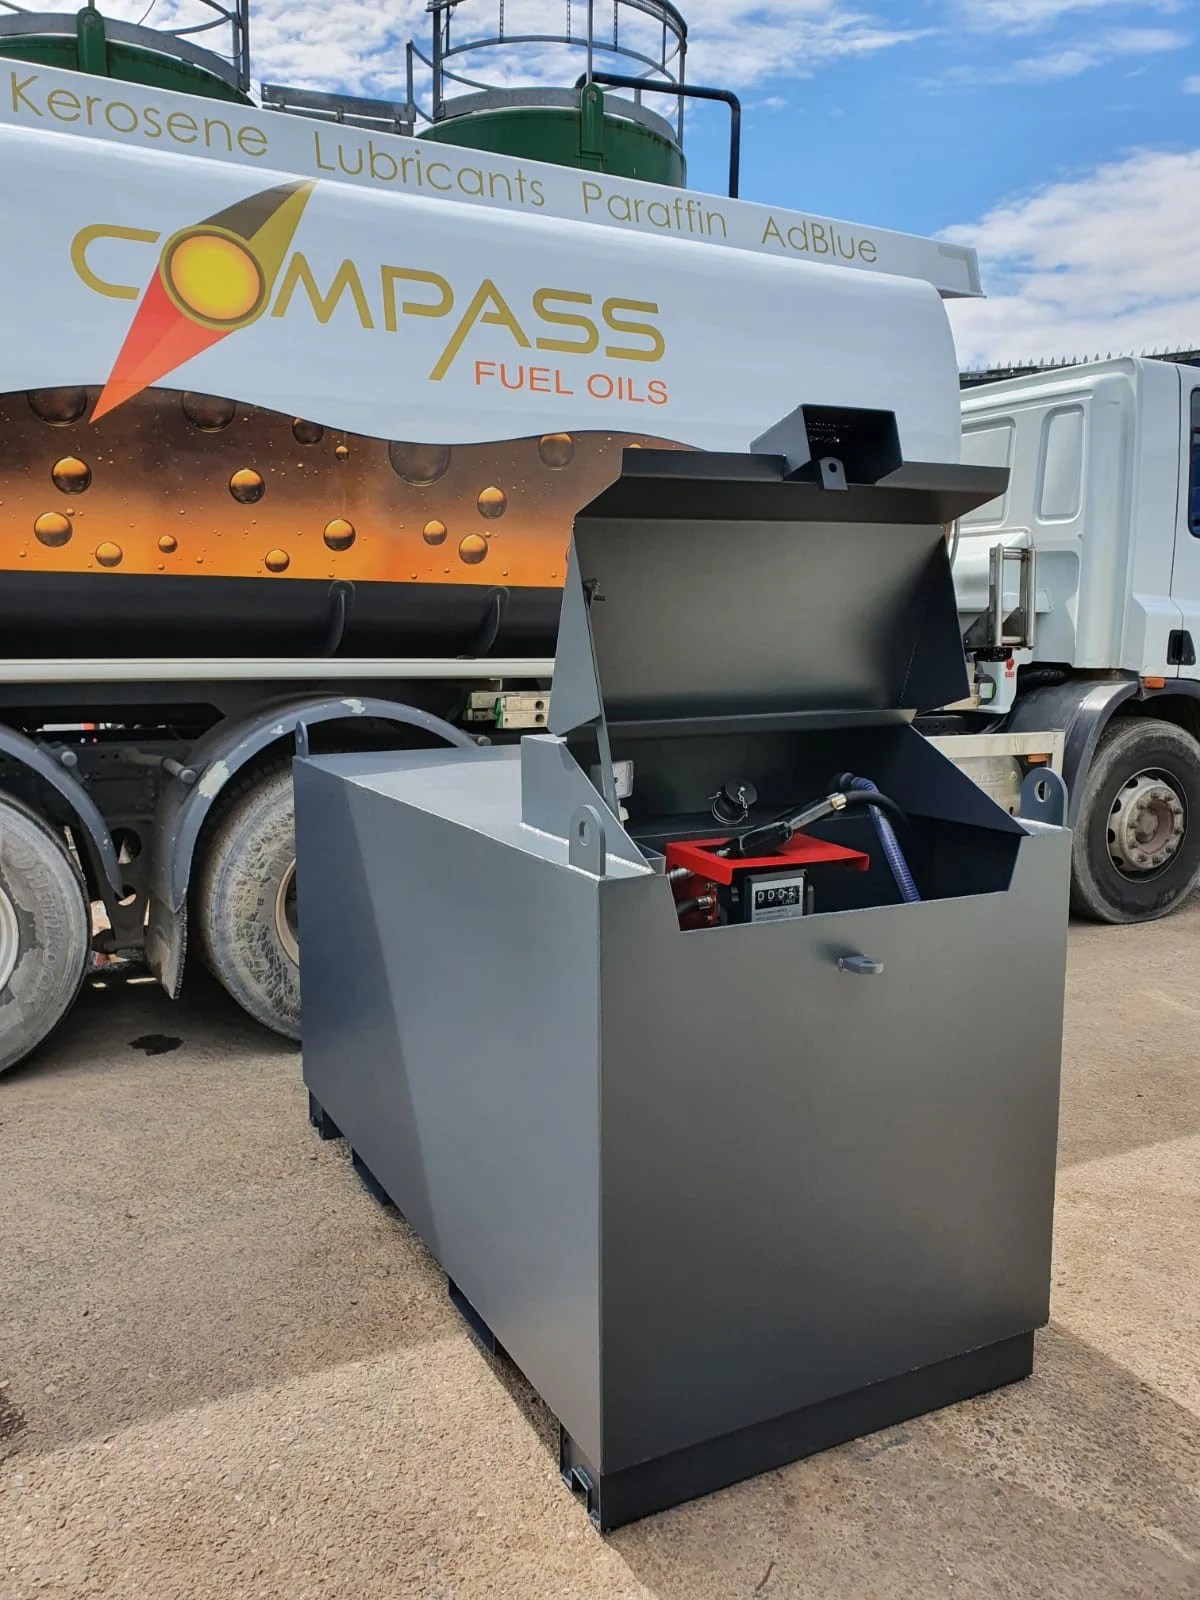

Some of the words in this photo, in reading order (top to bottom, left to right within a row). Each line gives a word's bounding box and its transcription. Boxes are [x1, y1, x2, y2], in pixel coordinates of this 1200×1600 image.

[10, 70, 268, 157] Kerosene
[314, 131, 546, 207] Lubricants
[581, 181, 727, 238] Paraffin
[761, 216, 877, 263] AdBlue
[70, 222, 666, 381] COMPASS
[474, 361, 574, 395] FUEL
[587, 373, 668, 405] OILS
